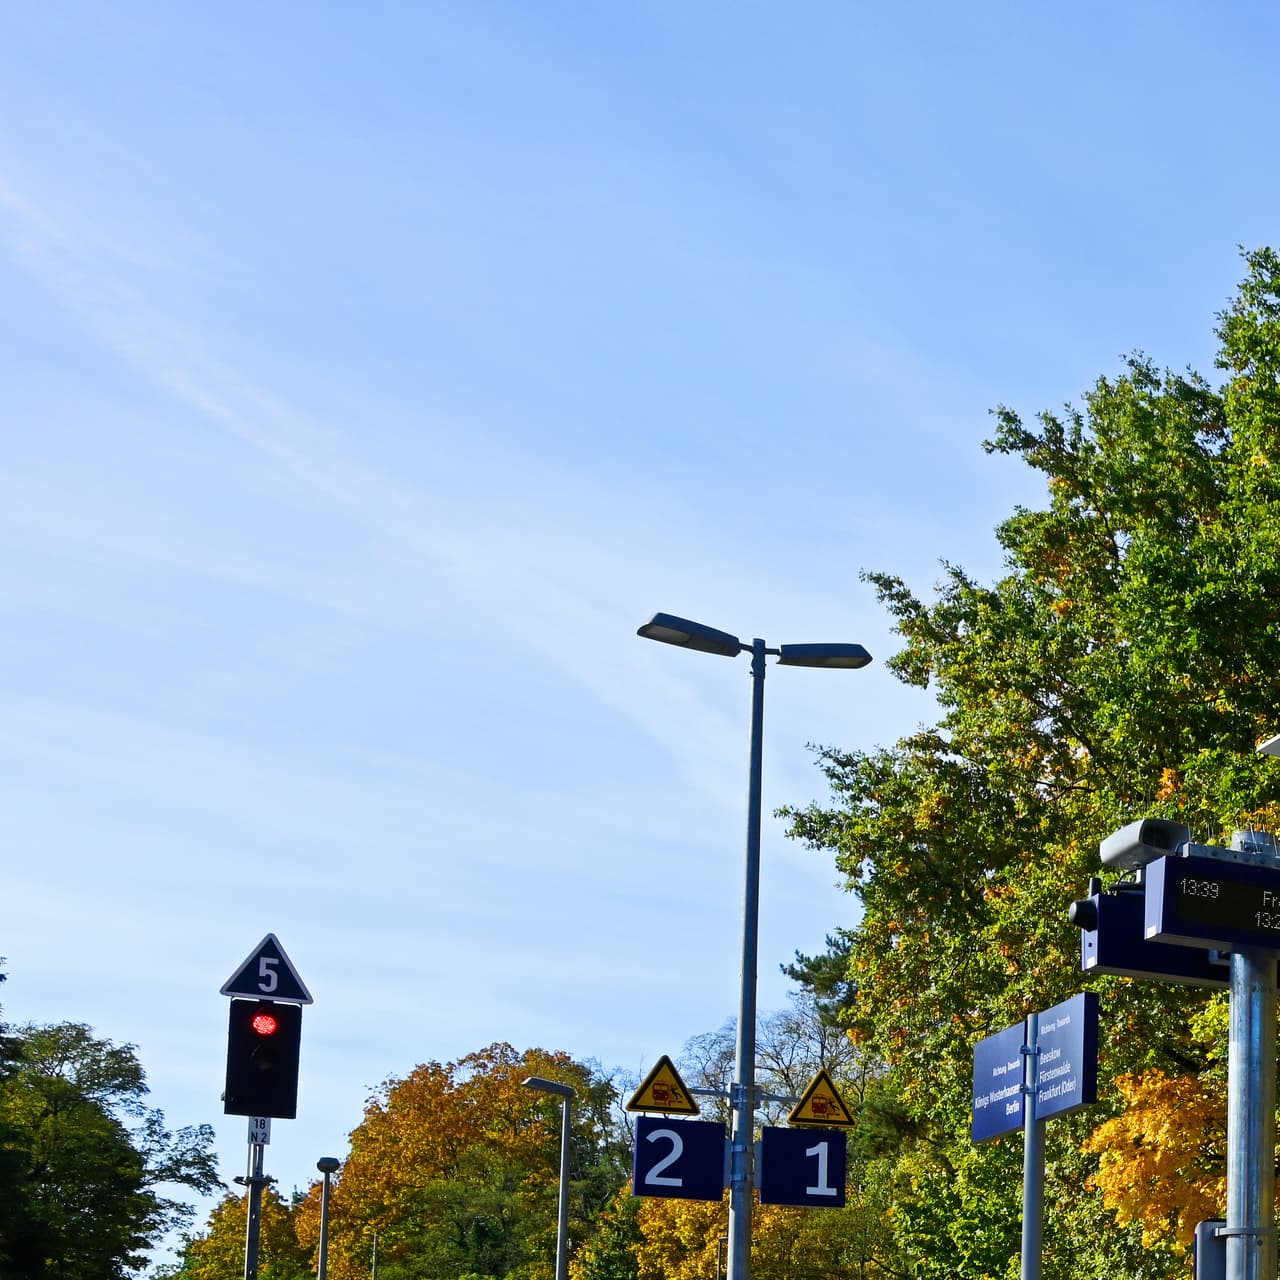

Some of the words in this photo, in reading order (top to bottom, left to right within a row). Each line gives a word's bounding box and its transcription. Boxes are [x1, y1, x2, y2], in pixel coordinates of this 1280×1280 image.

[1180, 878, 1219, 899] 13:39
[258, 956, 279, 993] 5
[1040, 1047, 1061, 1065] Beeskow
[1039, 1059, 1071, 1084] Fürstenwalde
[975, 1094, 990, 1109] Königs
[1039, 1082, 1061, 1104] Frankfurt
[1061, 1076, 1077, 1095] (Oder)
[1005, 1100, 1020, 1115] Berlin
[253, 1118, 266, 1130] 18
[644, 1128, 684, 1187] 2
[805, 1141, 838, 1196] 1
